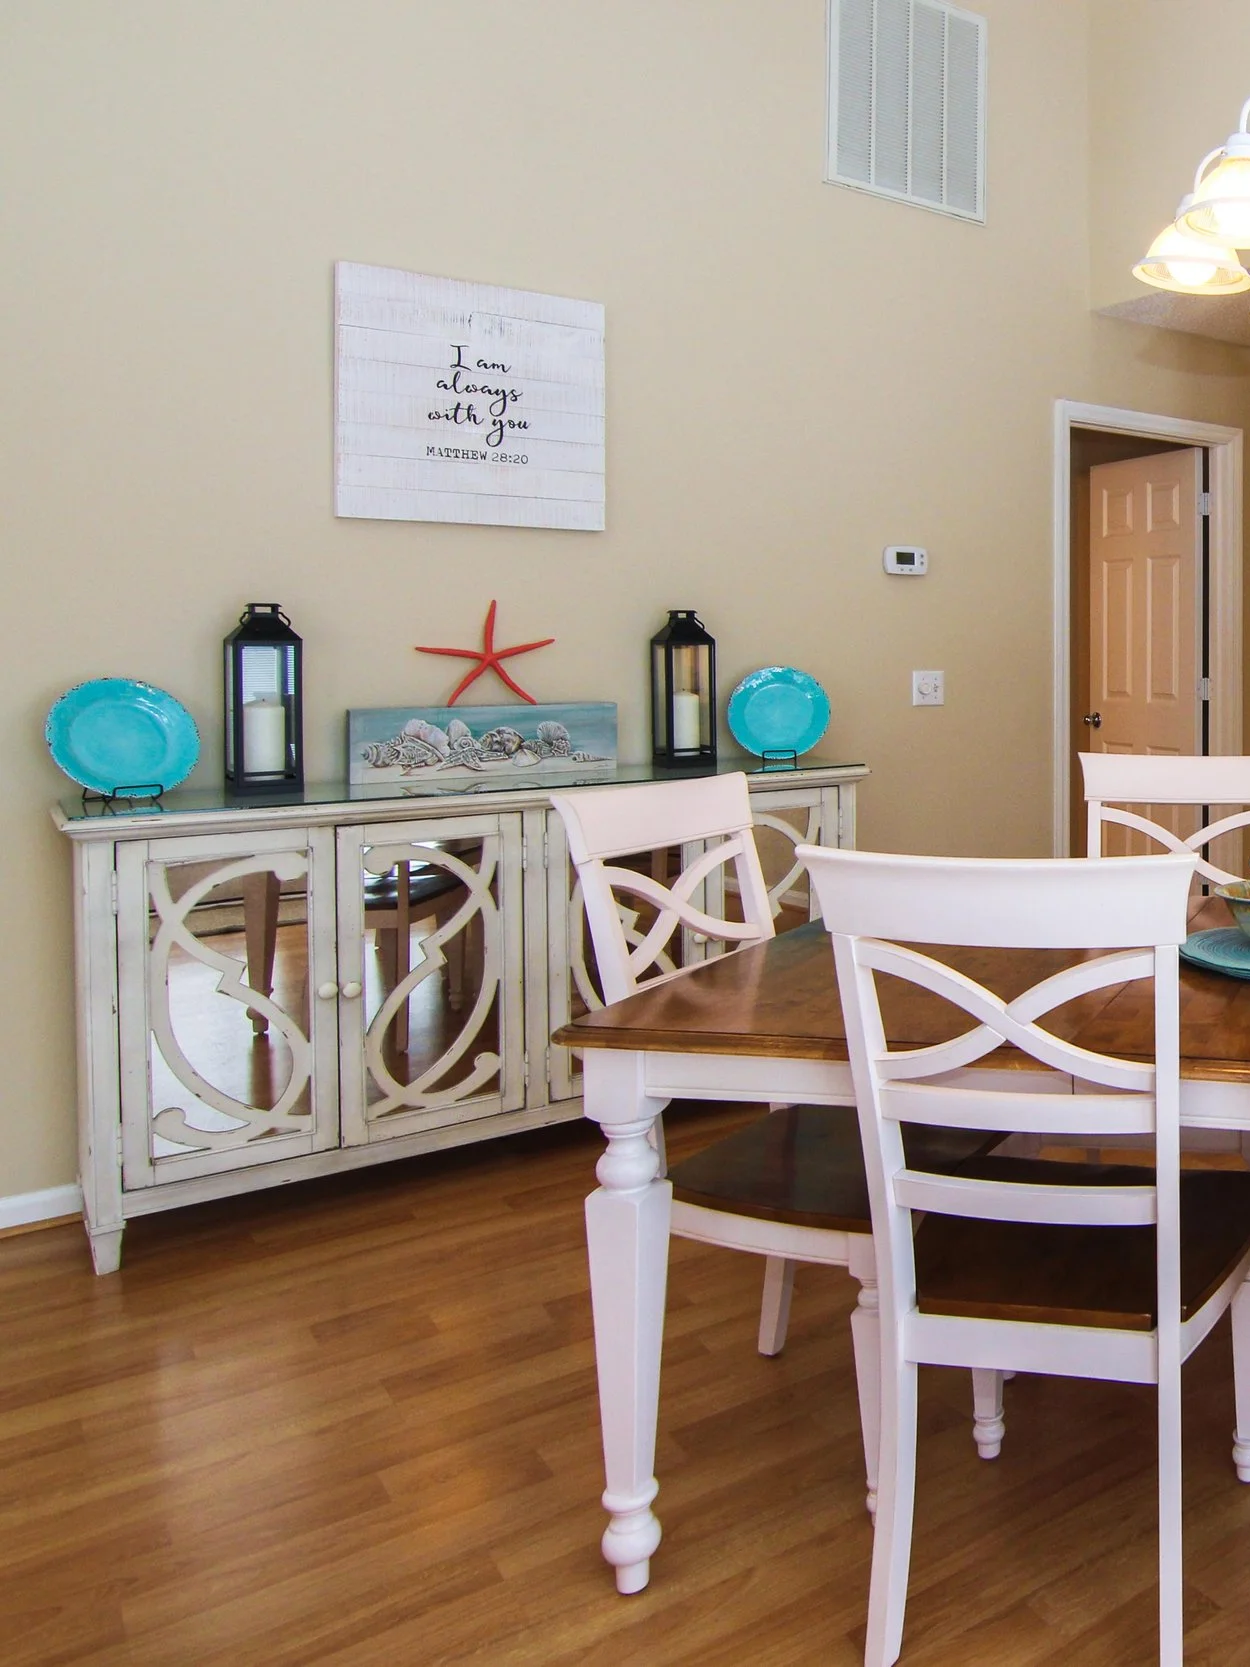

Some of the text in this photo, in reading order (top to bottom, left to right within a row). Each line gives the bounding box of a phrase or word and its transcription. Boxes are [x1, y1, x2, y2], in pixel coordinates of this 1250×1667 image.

[450, 344, 512, 374] I am
[436, 370, 523, 417] always
[428, 402, 532, 448] with you
[426, 446, 529, 465] MATTHEW 28:20
